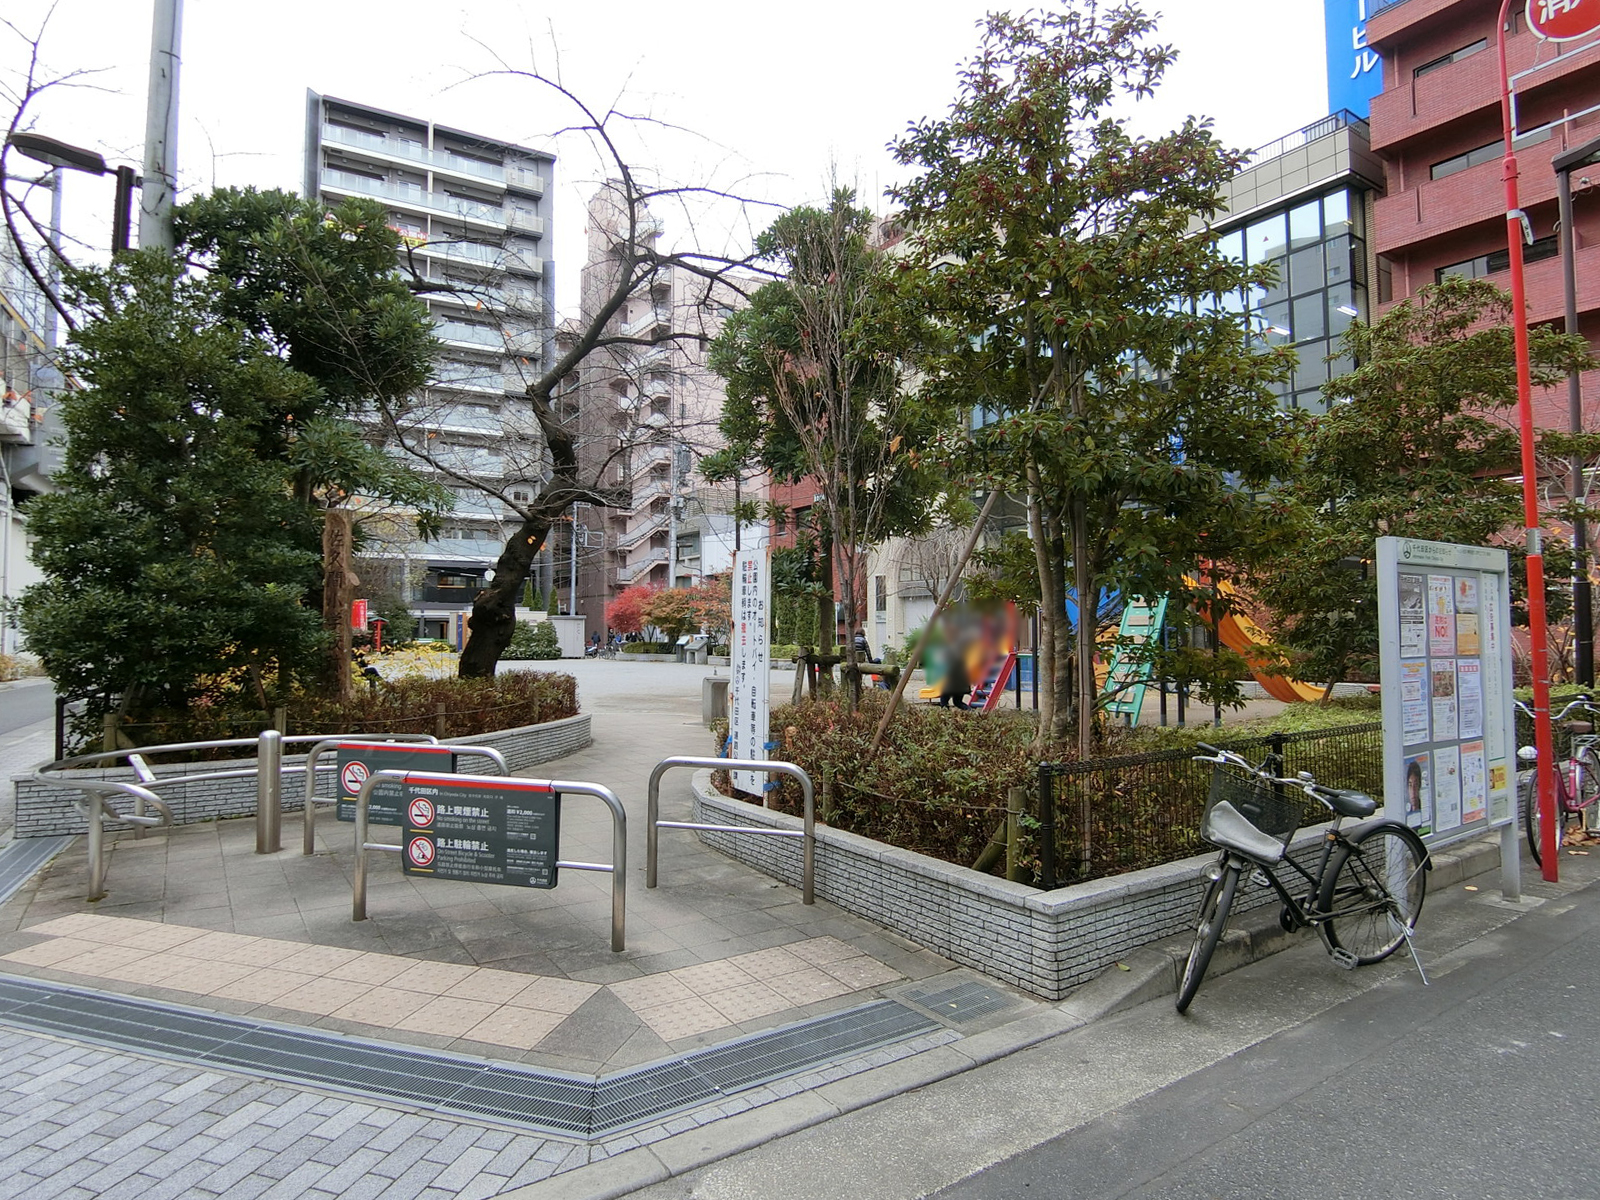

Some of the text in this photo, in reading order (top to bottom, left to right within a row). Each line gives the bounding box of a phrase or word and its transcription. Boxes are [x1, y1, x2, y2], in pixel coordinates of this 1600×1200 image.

[408, 786, 439, 796] 千代田区内
[437, 804, 489, 818] 路上喫煙禁止
[437, 837, 489, 851] 路上駐輪禁止
